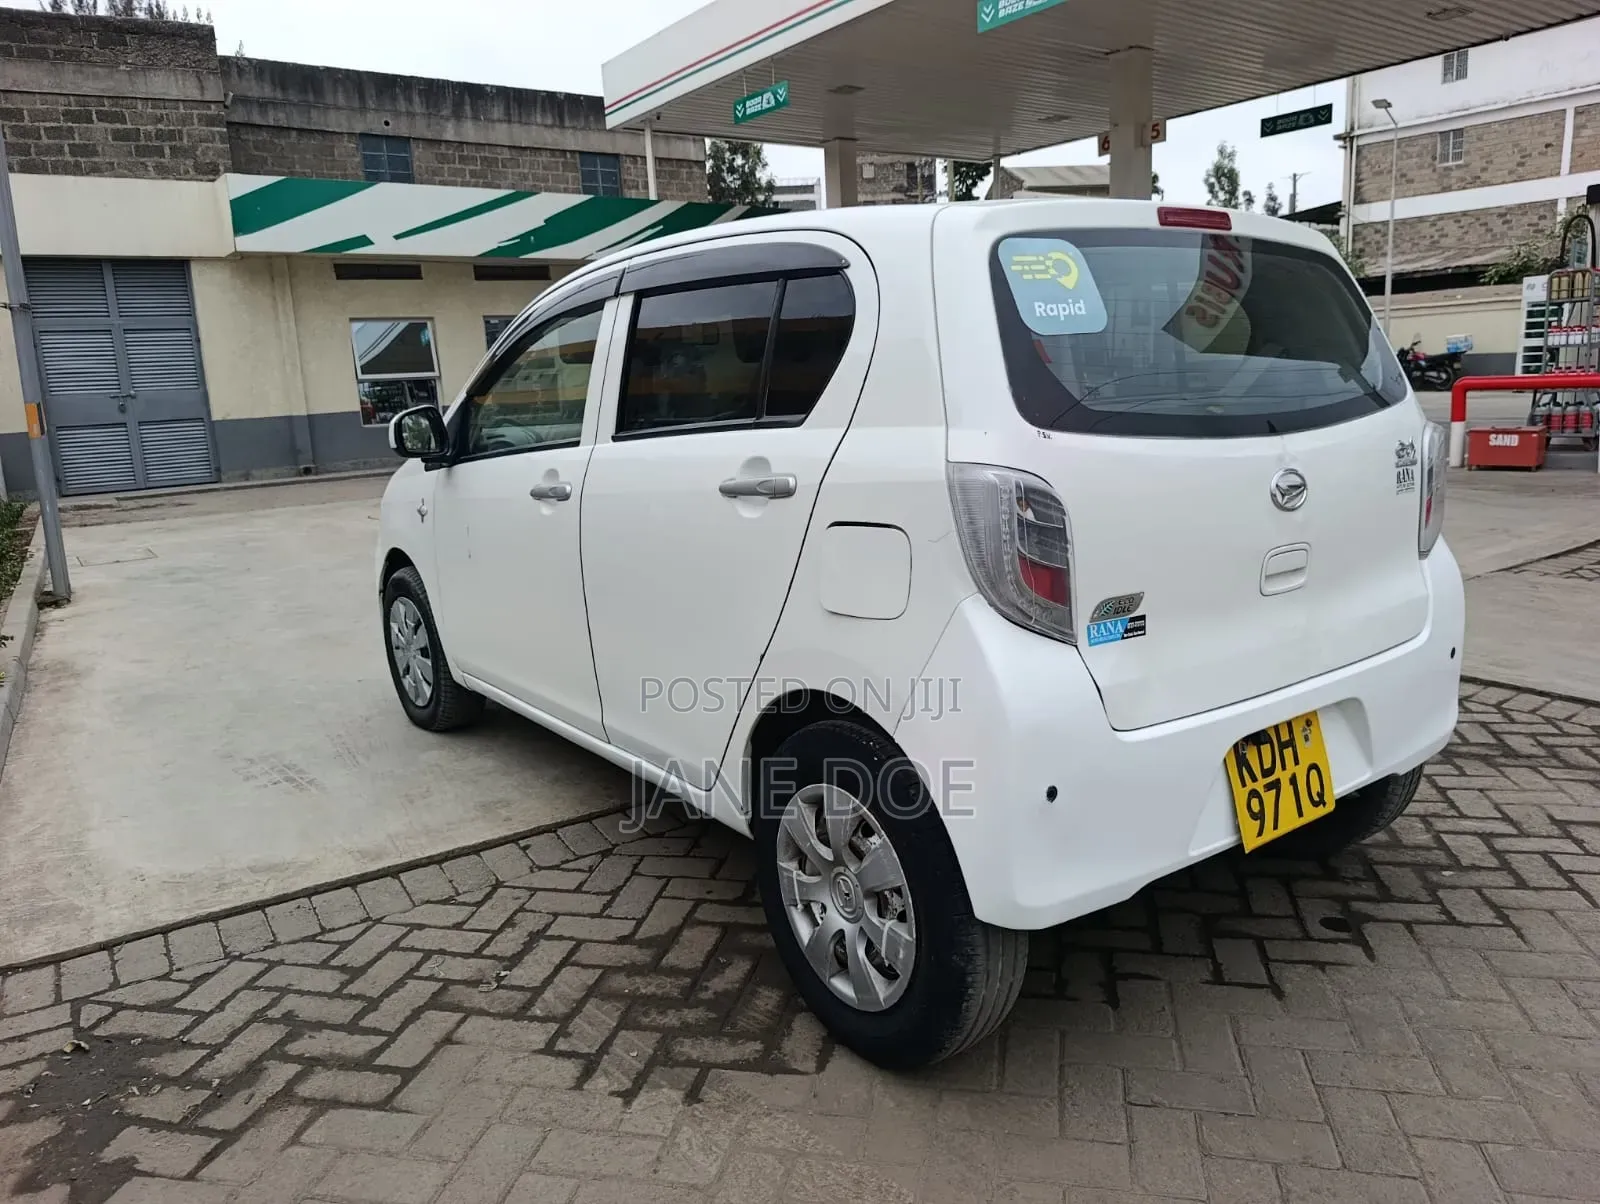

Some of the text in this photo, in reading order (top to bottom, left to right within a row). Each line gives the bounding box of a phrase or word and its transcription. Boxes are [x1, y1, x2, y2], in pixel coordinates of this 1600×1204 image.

[1151, 123, 1161, 140] 5
[1102, 136, 1110, 152] 6
[1033, 298, 1087, 321] Rapid
[1489, 434, 1519, 447] SAND
[1113, 604, 1133, 615] IDLE
[1090, 620, 1124, 638] RANA
[1232, 719, 1300, 788] KDH
[1246, 763, 1327, 838] 971Q
